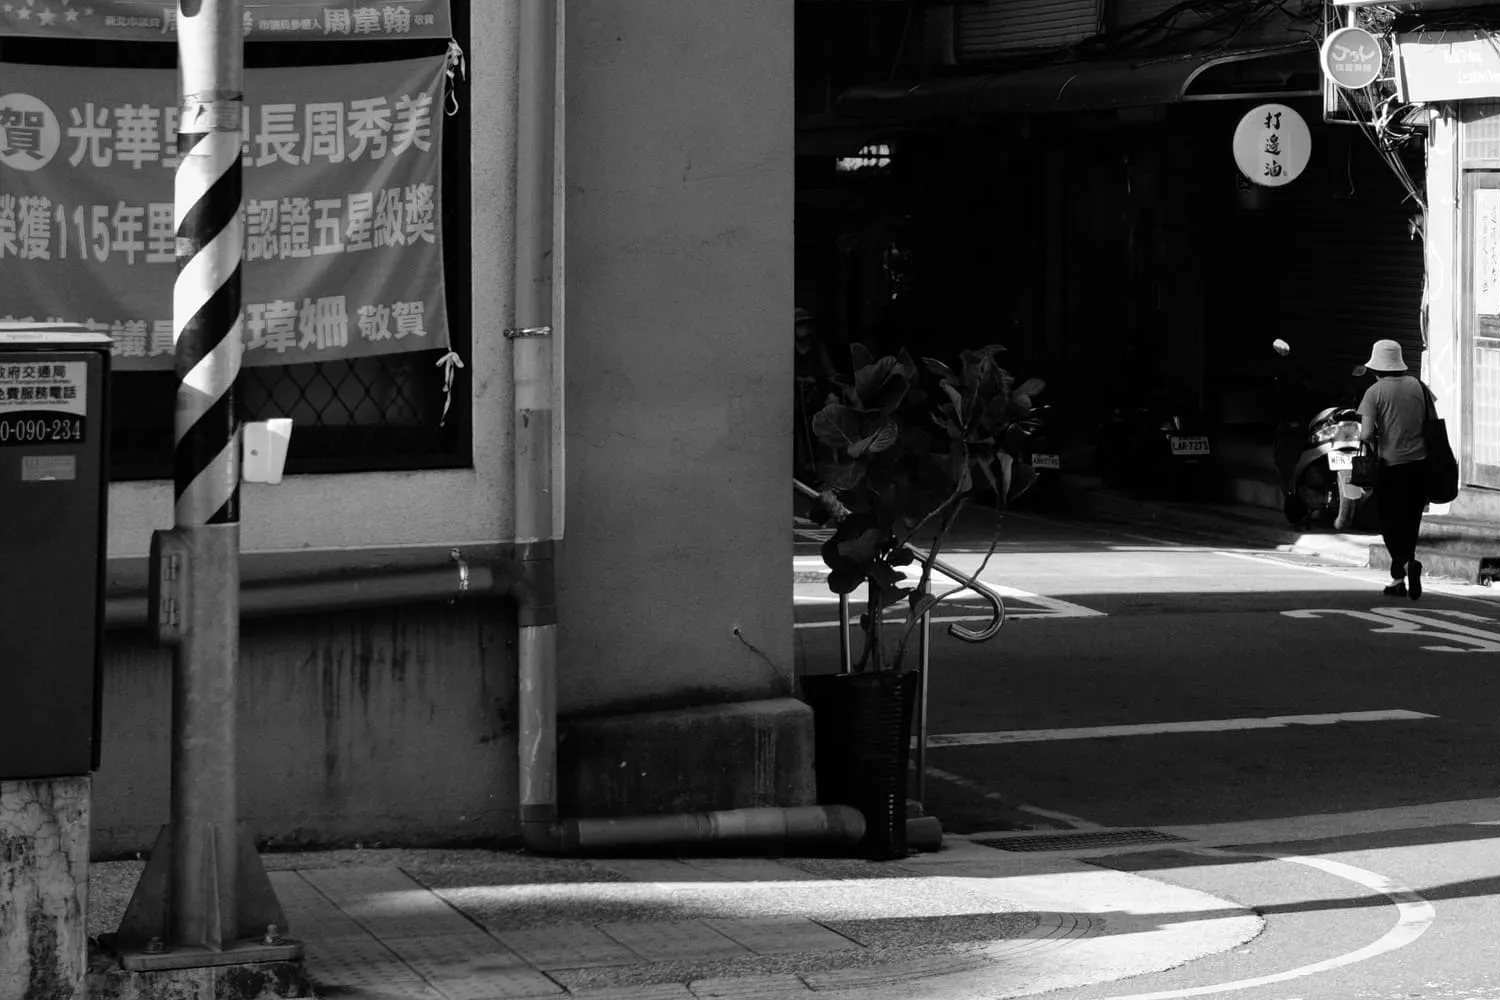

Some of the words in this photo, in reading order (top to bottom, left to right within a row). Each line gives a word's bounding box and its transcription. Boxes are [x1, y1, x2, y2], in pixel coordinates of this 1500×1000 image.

[0, 106, 45, 160] 賀
[68, 93, 433, 169] 光華長周秀美
[242, 296, 348, 353] 瑋姍
[357, 300, 427, 342] 敬賀
